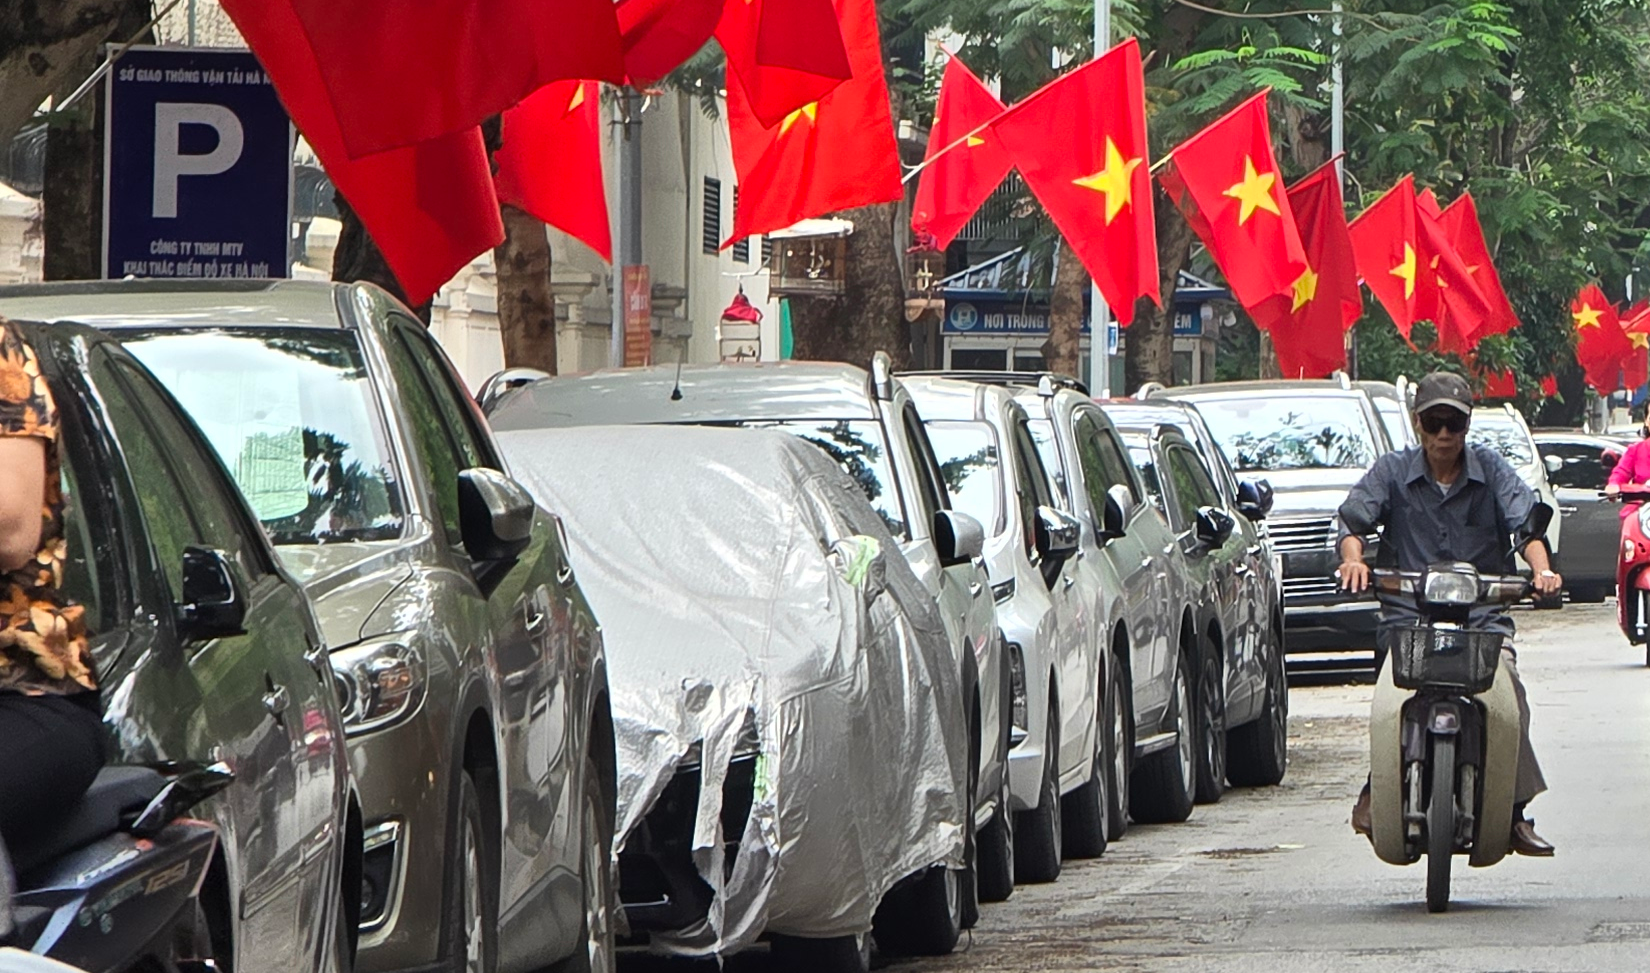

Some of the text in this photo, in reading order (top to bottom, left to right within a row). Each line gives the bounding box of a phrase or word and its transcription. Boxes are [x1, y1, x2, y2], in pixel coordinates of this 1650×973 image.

[136, 68, 162, 82] GIAO
[164, 68, 199, 84] THÔNG
[202, 69, 224, 87] VẬN
[152, 102, 244, 218] P
[150, 238, 244, 257] CÔNG TY TNHH MTV
[123, 260, 147, 275] KHAI
[150, 259, 174, 276] THÁC
[220, 262, 232, 278] XE
[984, 313, 1004, 329] NƠI
